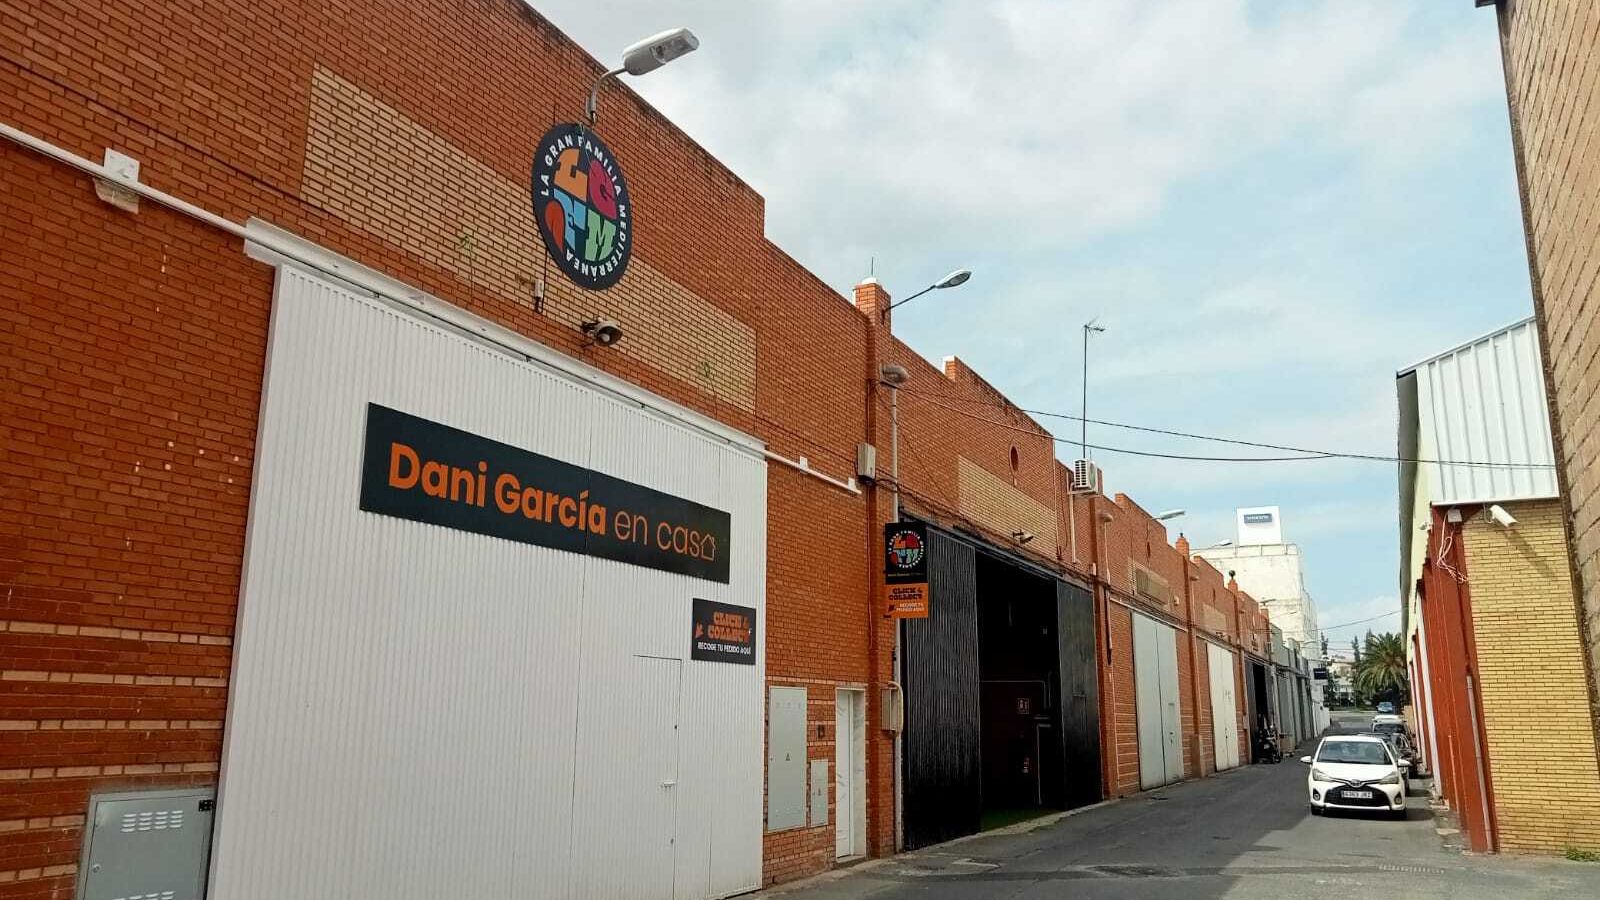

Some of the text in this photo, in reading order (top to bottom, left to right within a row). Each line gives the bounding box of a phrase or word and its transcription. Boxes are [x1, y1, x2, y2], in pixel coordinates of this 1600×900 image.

[540, 134, 627, 282] LA GRAN FAMILIA MEDITERRÁNEA
[388, 442, 487, 508] Dani
[494, 472, 608, 536] García
[614, 509, 648, 546] en
[698, 642, 717, 651] RECOGE
[717, 643, 723, 651] TU
[724, 644, 739, 653] PEDIDO
